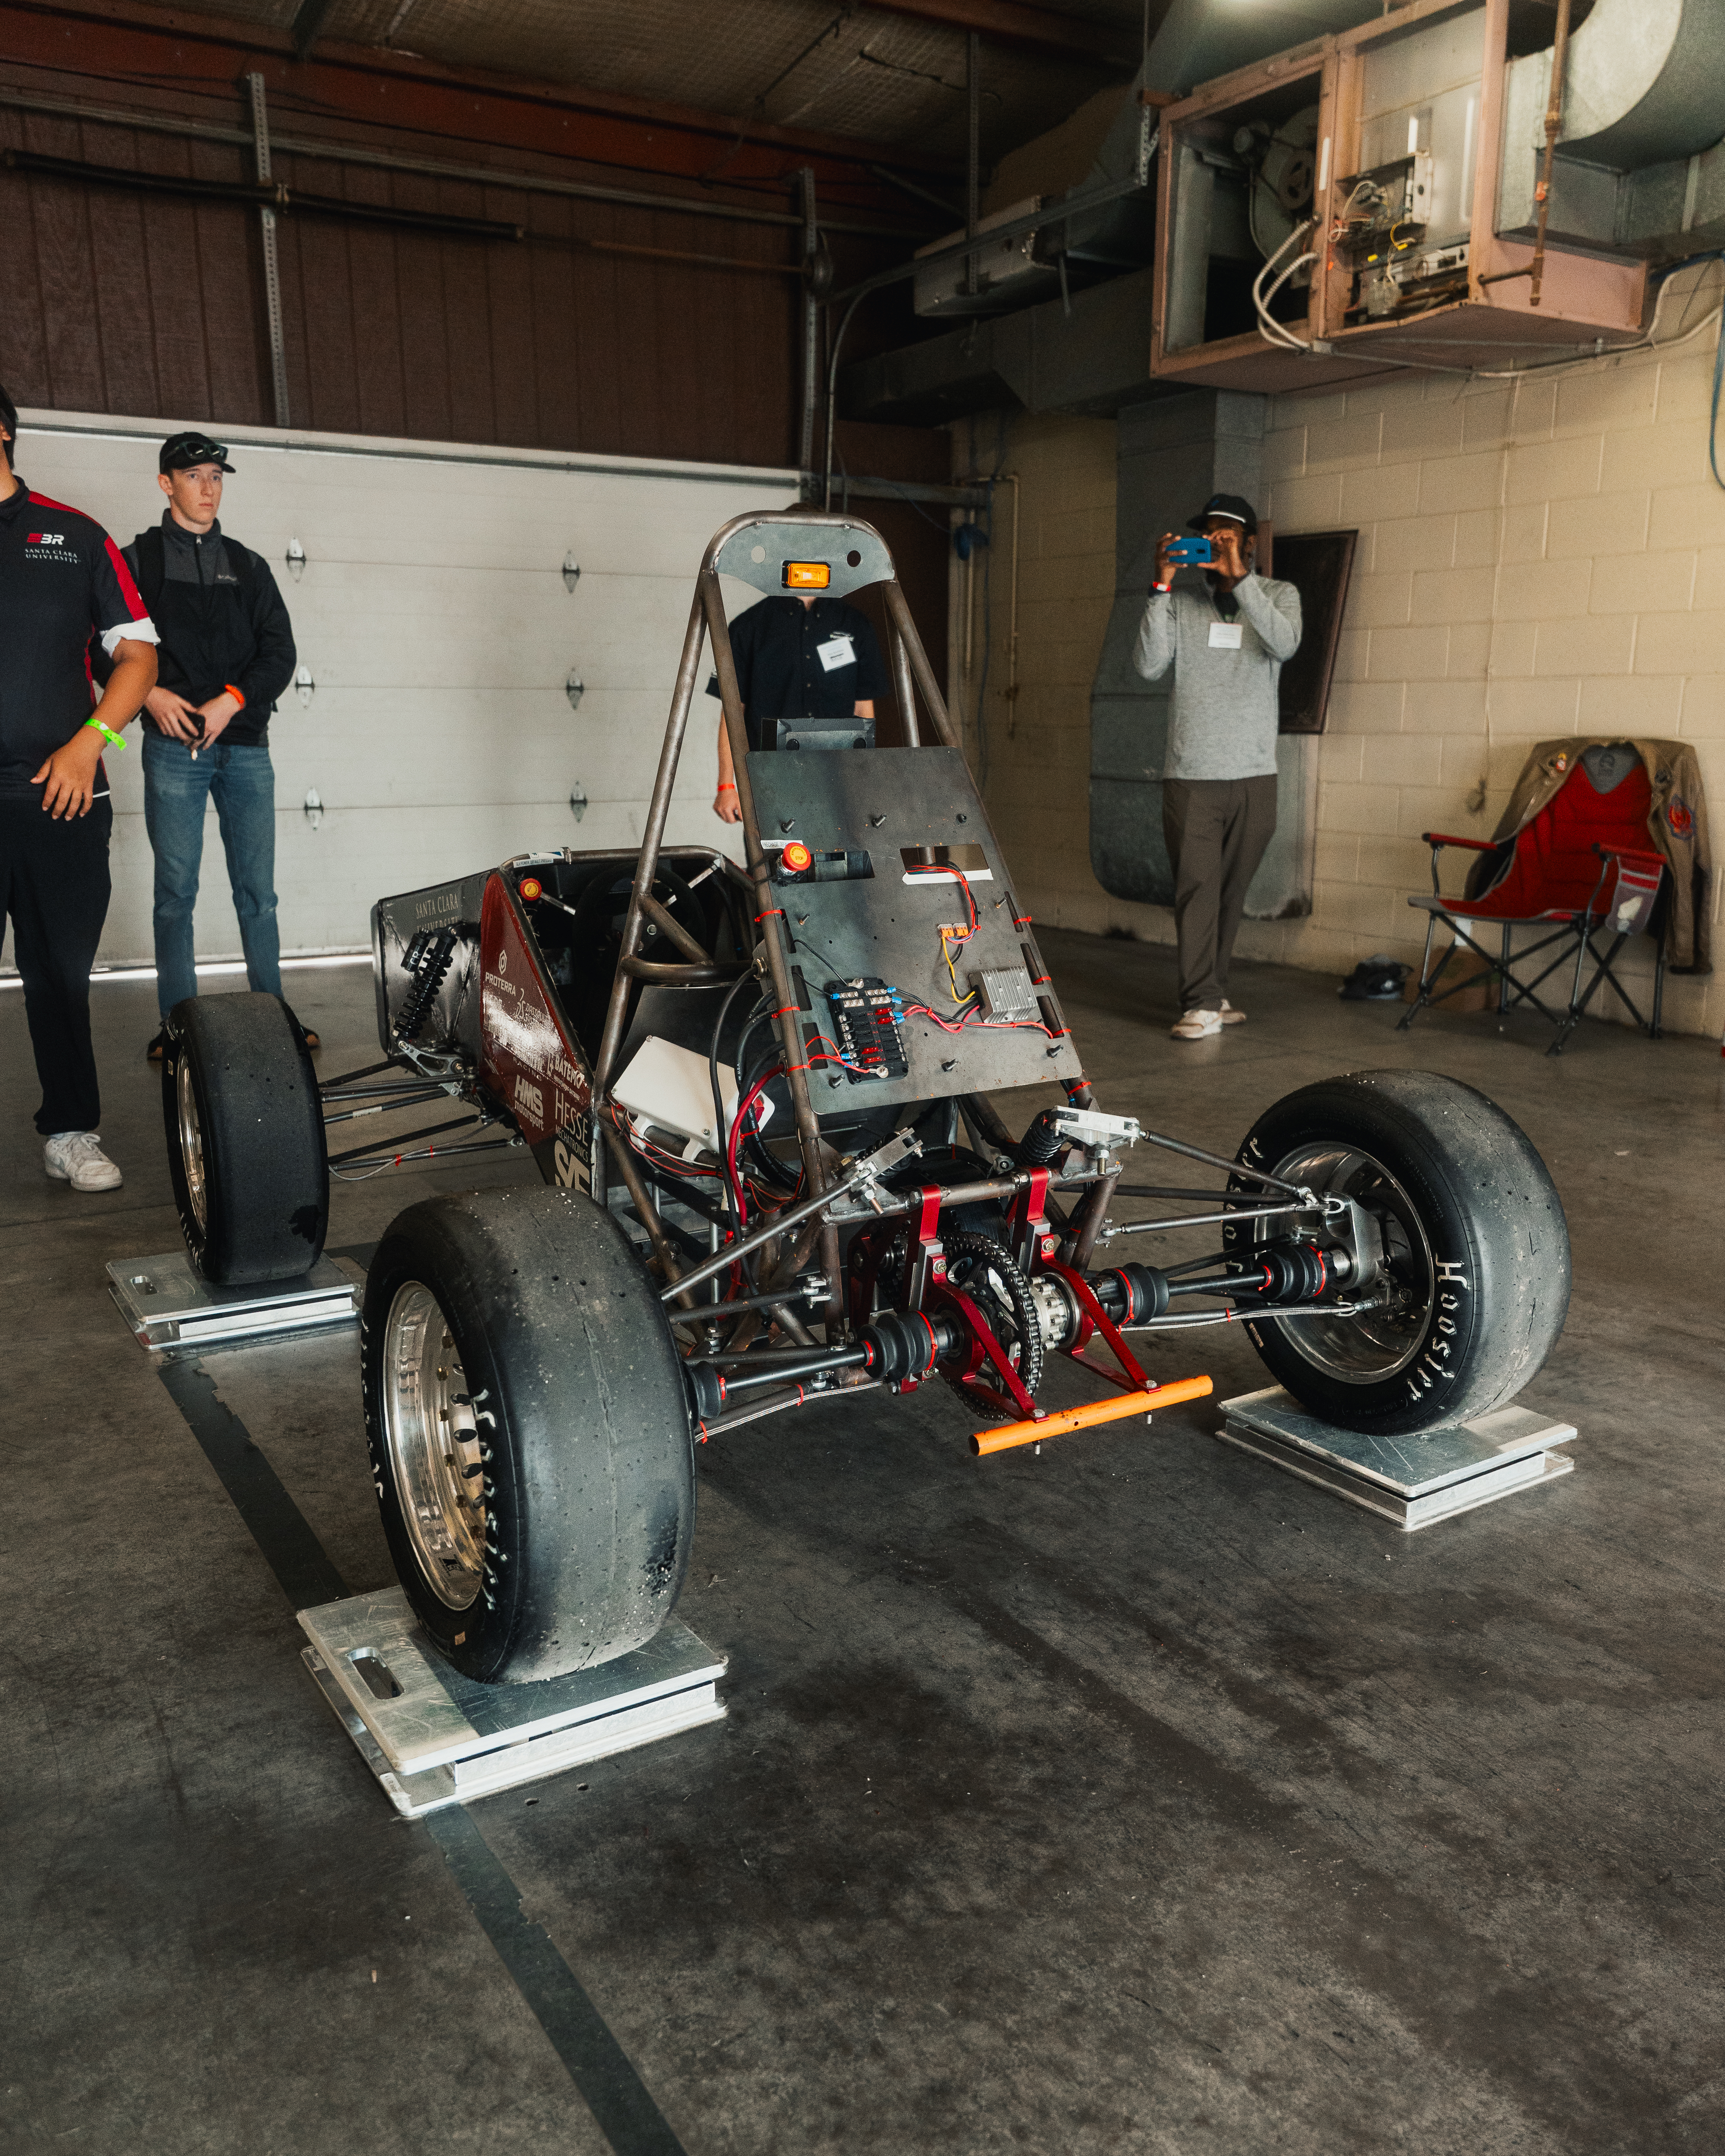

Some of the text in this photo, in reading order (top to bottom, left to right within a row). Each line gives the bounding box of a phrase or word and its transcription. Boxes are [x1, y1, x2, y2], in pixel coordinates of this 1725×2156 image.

[26, 554, 77, 563] UNIVERSITY
[53, 550, 77, 558] CLARA
[791, 847, 806, 855] EMERGENCY
[416, 894, 458, 919] SANTA CLARA
[485, 971, 516, 997] PROTERRA
[513, 1057, 542, 1081] RACING
[555, 1054, 585, 1089] BATEMO
[515, 1074, 543, 1117] HMS
[515, 1100, 544, 1131] motorsport
[555, 1088, 588, 1147] HESSE
[556, 1124, 588, 1162] MECHATRONICS
[758, 1142, 766, 1156] WELDING
